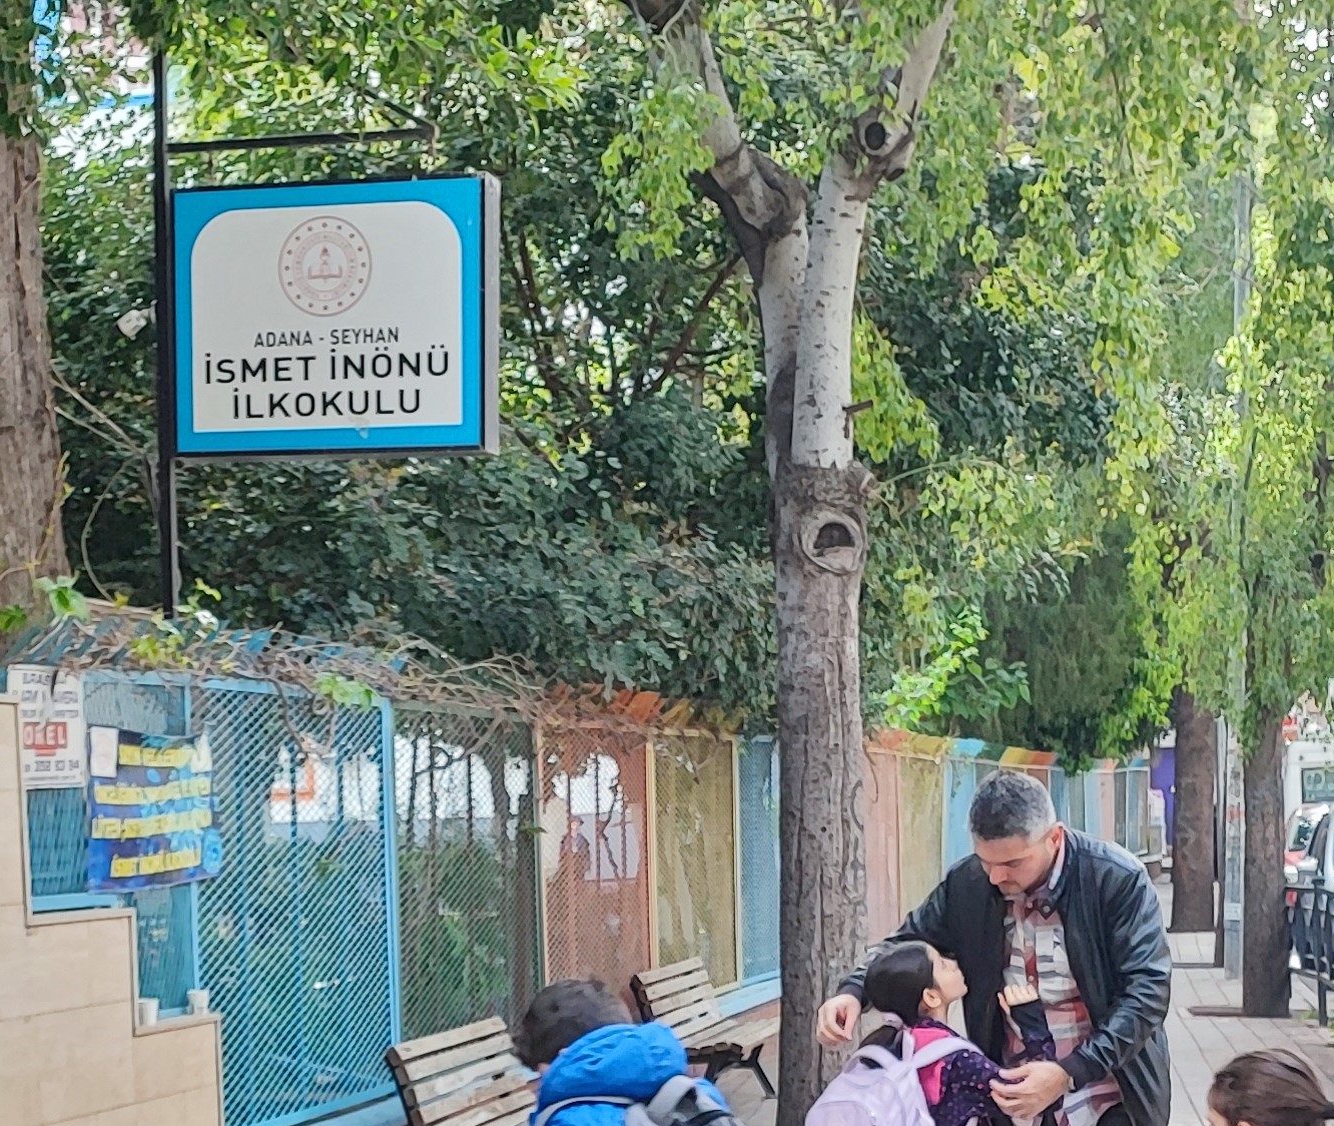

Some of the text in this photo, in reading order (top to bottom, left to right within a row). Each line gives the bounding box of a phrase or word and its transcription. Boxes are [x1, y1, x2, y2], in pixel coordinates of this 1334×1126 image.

[253, 331, 313, 348] ADANA
[330, 327, 399, 345] SEYHAN
[205, 344, 449, 384] İSMET İNÖNÜ
[232, 388, 421, 419] İLKOKULU
